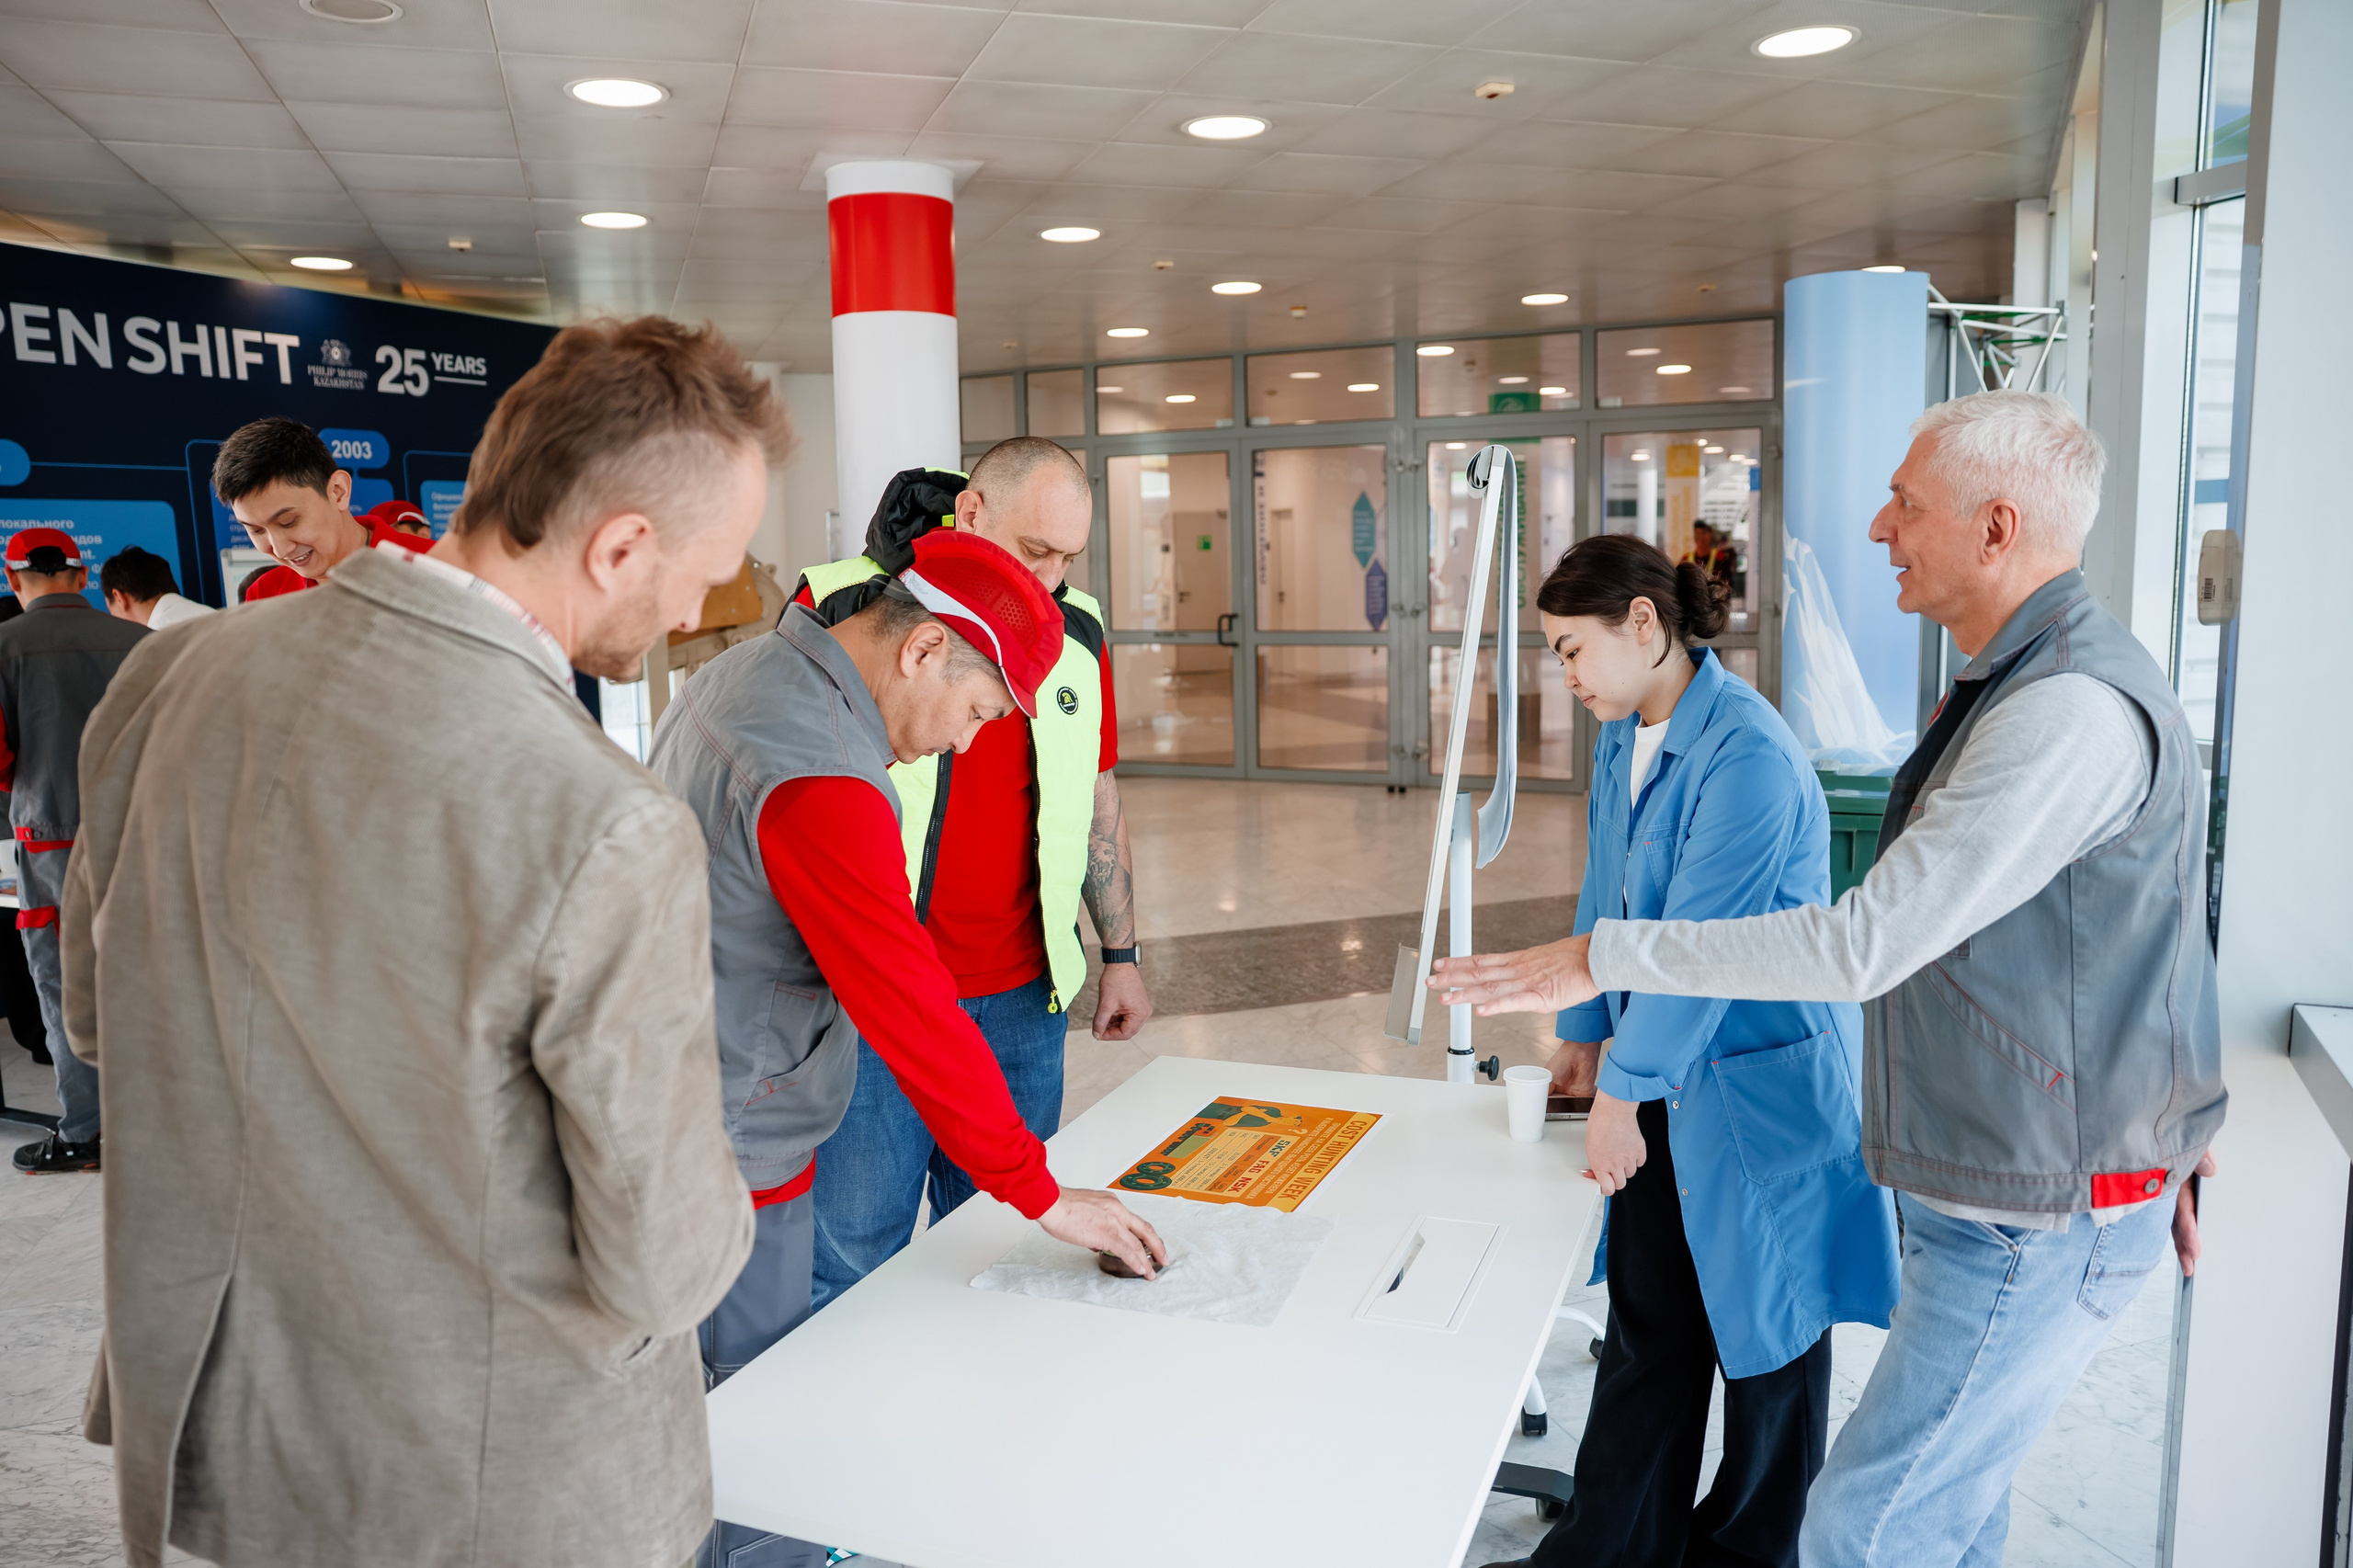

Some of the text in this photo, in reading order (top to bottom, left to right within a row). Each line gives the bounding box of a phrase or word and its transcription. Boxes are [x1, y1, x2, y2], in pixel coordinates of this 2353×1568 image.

[0, 301, 301, 384] EN SHIFT
[375, 345, 487, 397] 25 YEARS
[331, 439, 372, 460] 2003
[1226, 1140, 1291, 1192] SKF FAG NSK
[1276, 1119, 1369, 1200] COST HUNTING WEEK
